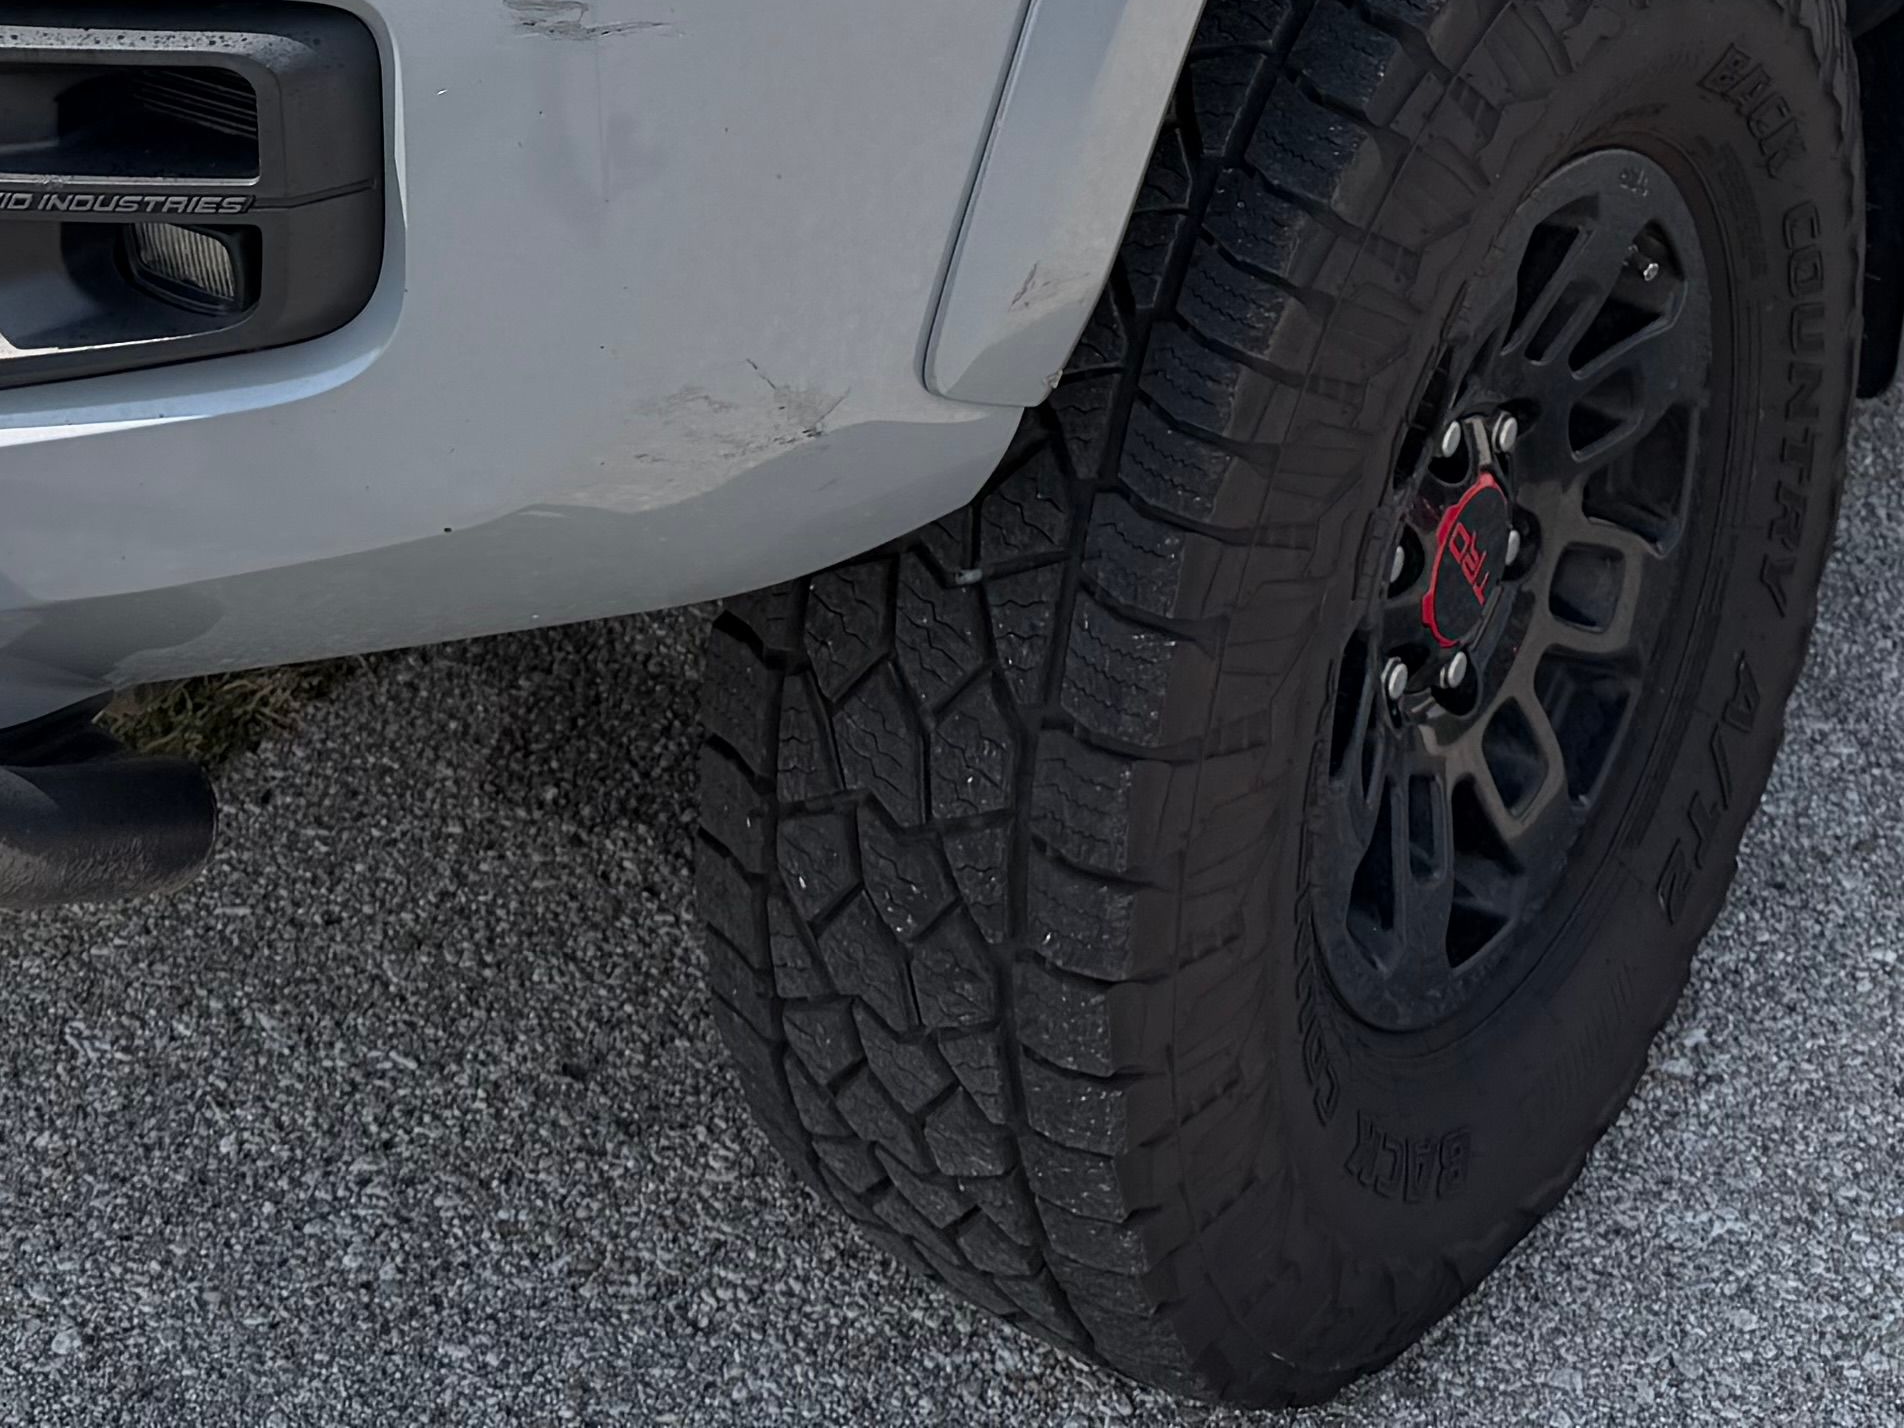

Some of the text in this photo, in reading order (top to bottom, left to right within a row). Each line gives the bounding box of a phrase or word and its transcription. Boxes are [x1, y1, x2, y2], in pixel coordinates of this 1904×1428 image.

[37, 193, 250, 214] INDUSTRIES
[1695, 42, 1807, 179] BACK
[1759, 198, 1825, 619] COUNTRY
[1448, 521, 1491, 607] TRD
